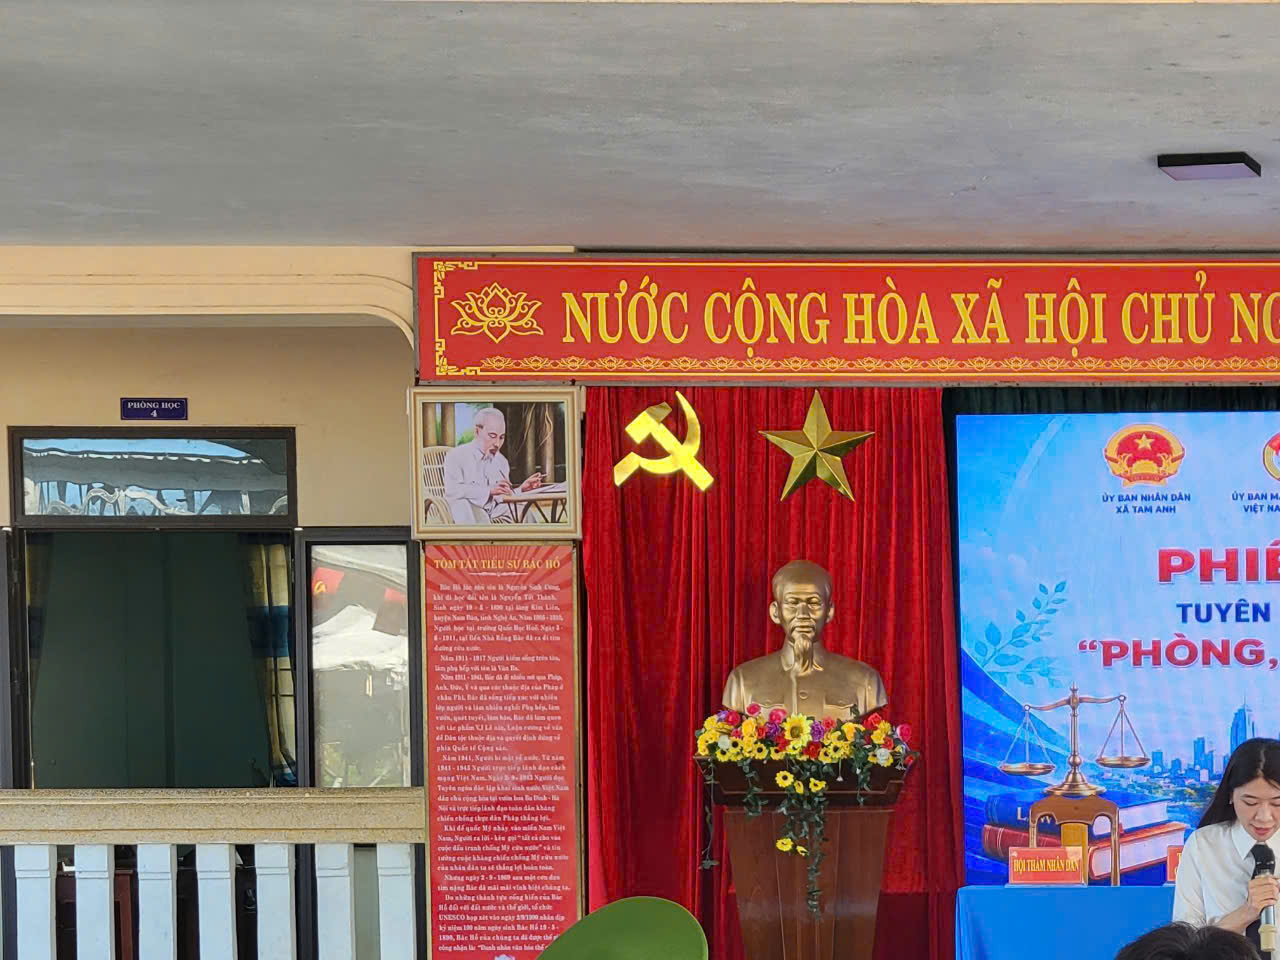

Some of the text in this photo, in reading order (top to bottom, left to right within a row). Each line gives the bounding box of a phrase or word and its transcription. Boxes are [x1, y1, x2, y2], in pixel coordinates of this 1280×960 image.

[562, 275, 690, 345] NƯỚC
[704, 278, 829, 358] CỘNG
[843, 276, 937, 345] HÒA
[952, 280, 1009, 345] XÃ
[1025, 277, 1107, 358] HỘI
[1121, 270, 1215, 345] CHỦ
[1102, 492, 1115, 502] ỦY
[1141, 492, 1168, 502] NHÂN
[1171, 492, 1190, 501] DÂN
[1232, 490, 1244, 501] ỦY
[1248, 493, 1267, 501] BAN
[1116, 504, 1129, 514] XÃ
[1244, 503, 1264, 514] VIỆT
[1176, 598, 1271, 624] TUYÊN
[1078, 632, 1278, 670] “PHÒNG,
[1016, 807, 1052, 824] LW
